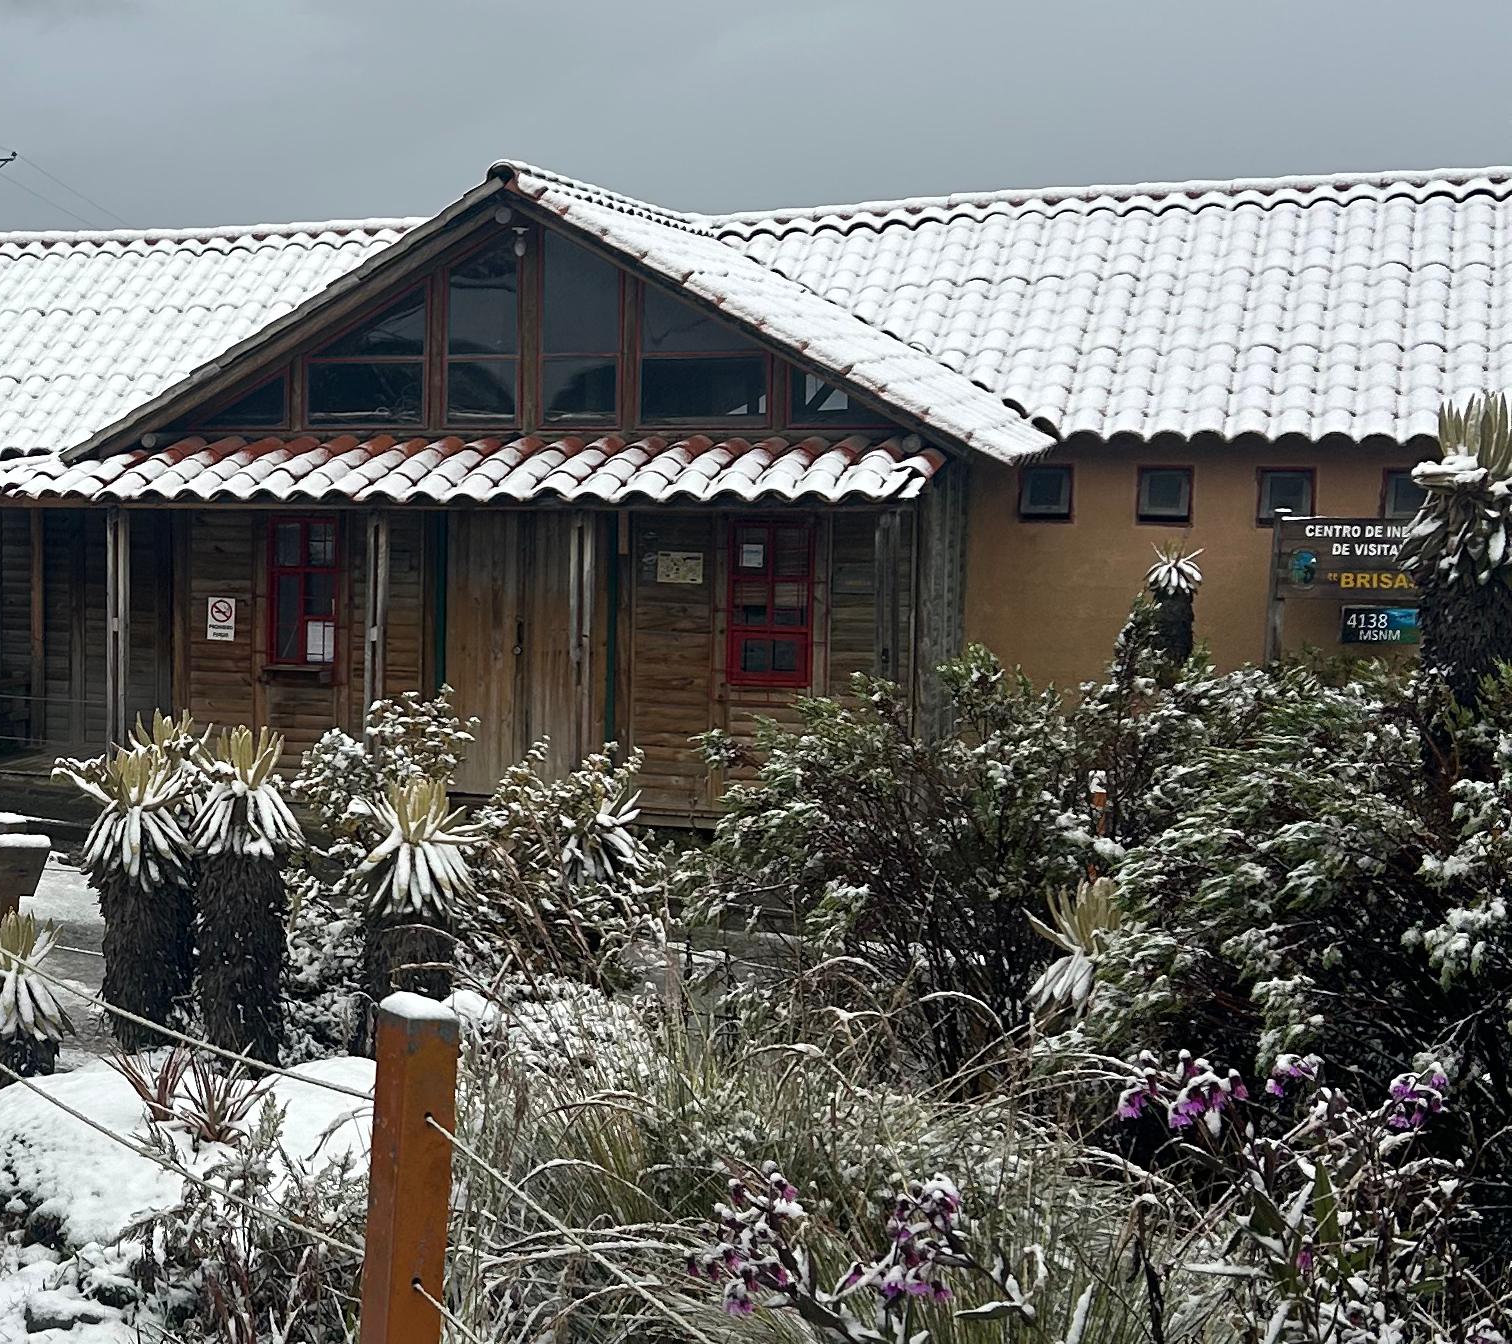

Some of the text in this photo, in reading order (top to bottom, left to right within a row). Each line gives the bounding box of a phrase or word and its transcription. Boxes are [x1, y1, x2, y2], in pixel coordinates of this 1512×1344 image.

[1305, 525, 1361, 538] CENTRO
[1364, 525, 1383, 538] DE
[1332, 543, 1403, 556] DE VISITA
[1347, 613, 1388, 629] 4138
[1359, 629, 1401, 641] MSNM
